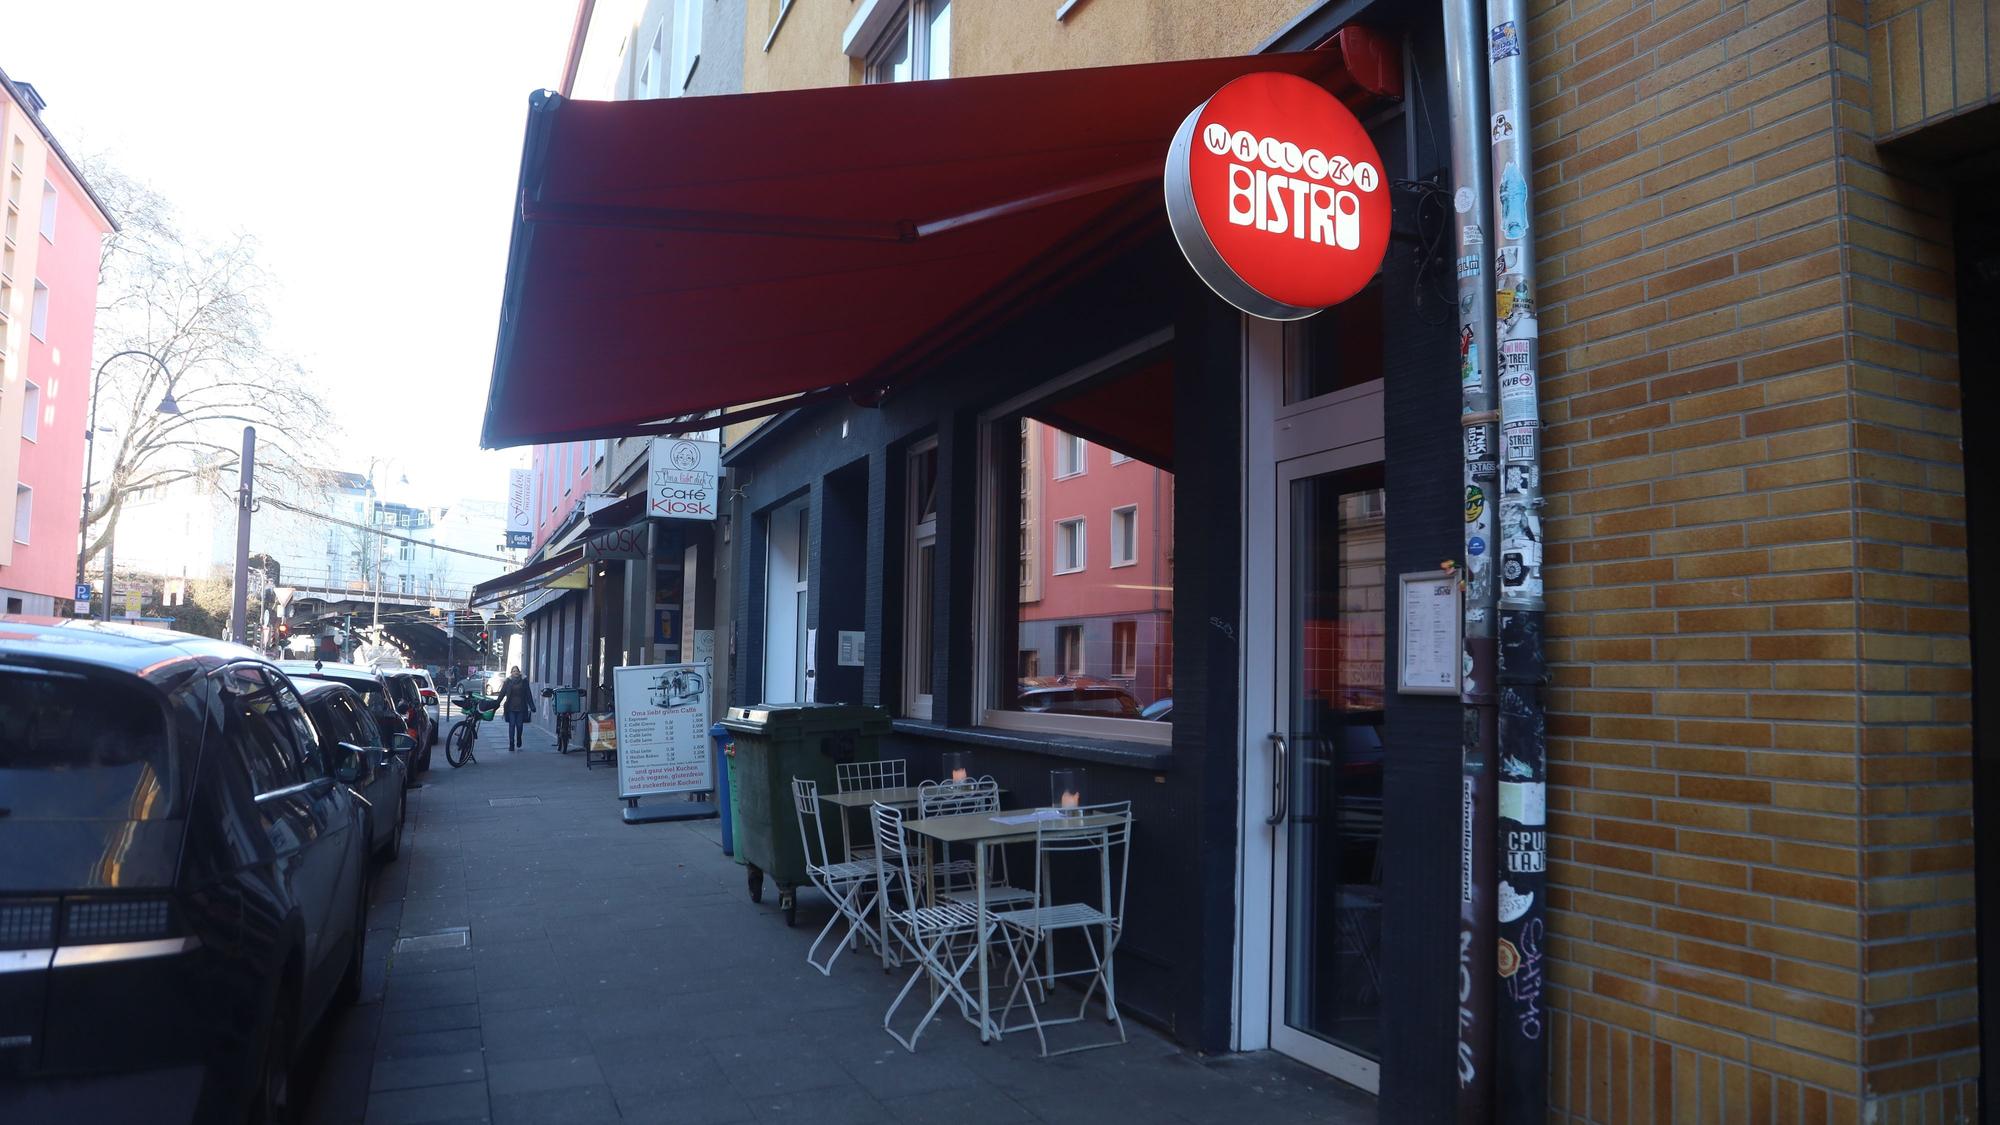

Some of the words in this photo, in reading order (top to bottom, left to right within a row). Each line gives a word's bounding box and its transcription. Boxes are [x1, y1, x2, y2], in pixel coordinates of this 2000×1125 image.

[1228, 162, 1360, 251] BISTRO
[1506, 353, 1529, 364] TREET
[1502, 376, 1519, 388] KVB
[1468, 427, 1477, 454] BDSM
[1508, 434, 1533, 446] STREET
[661, 487, 706, 500] Café
[652, 498, 713, 515] Kiosk
[1463, 782, 1472, 902] schnellejugend
